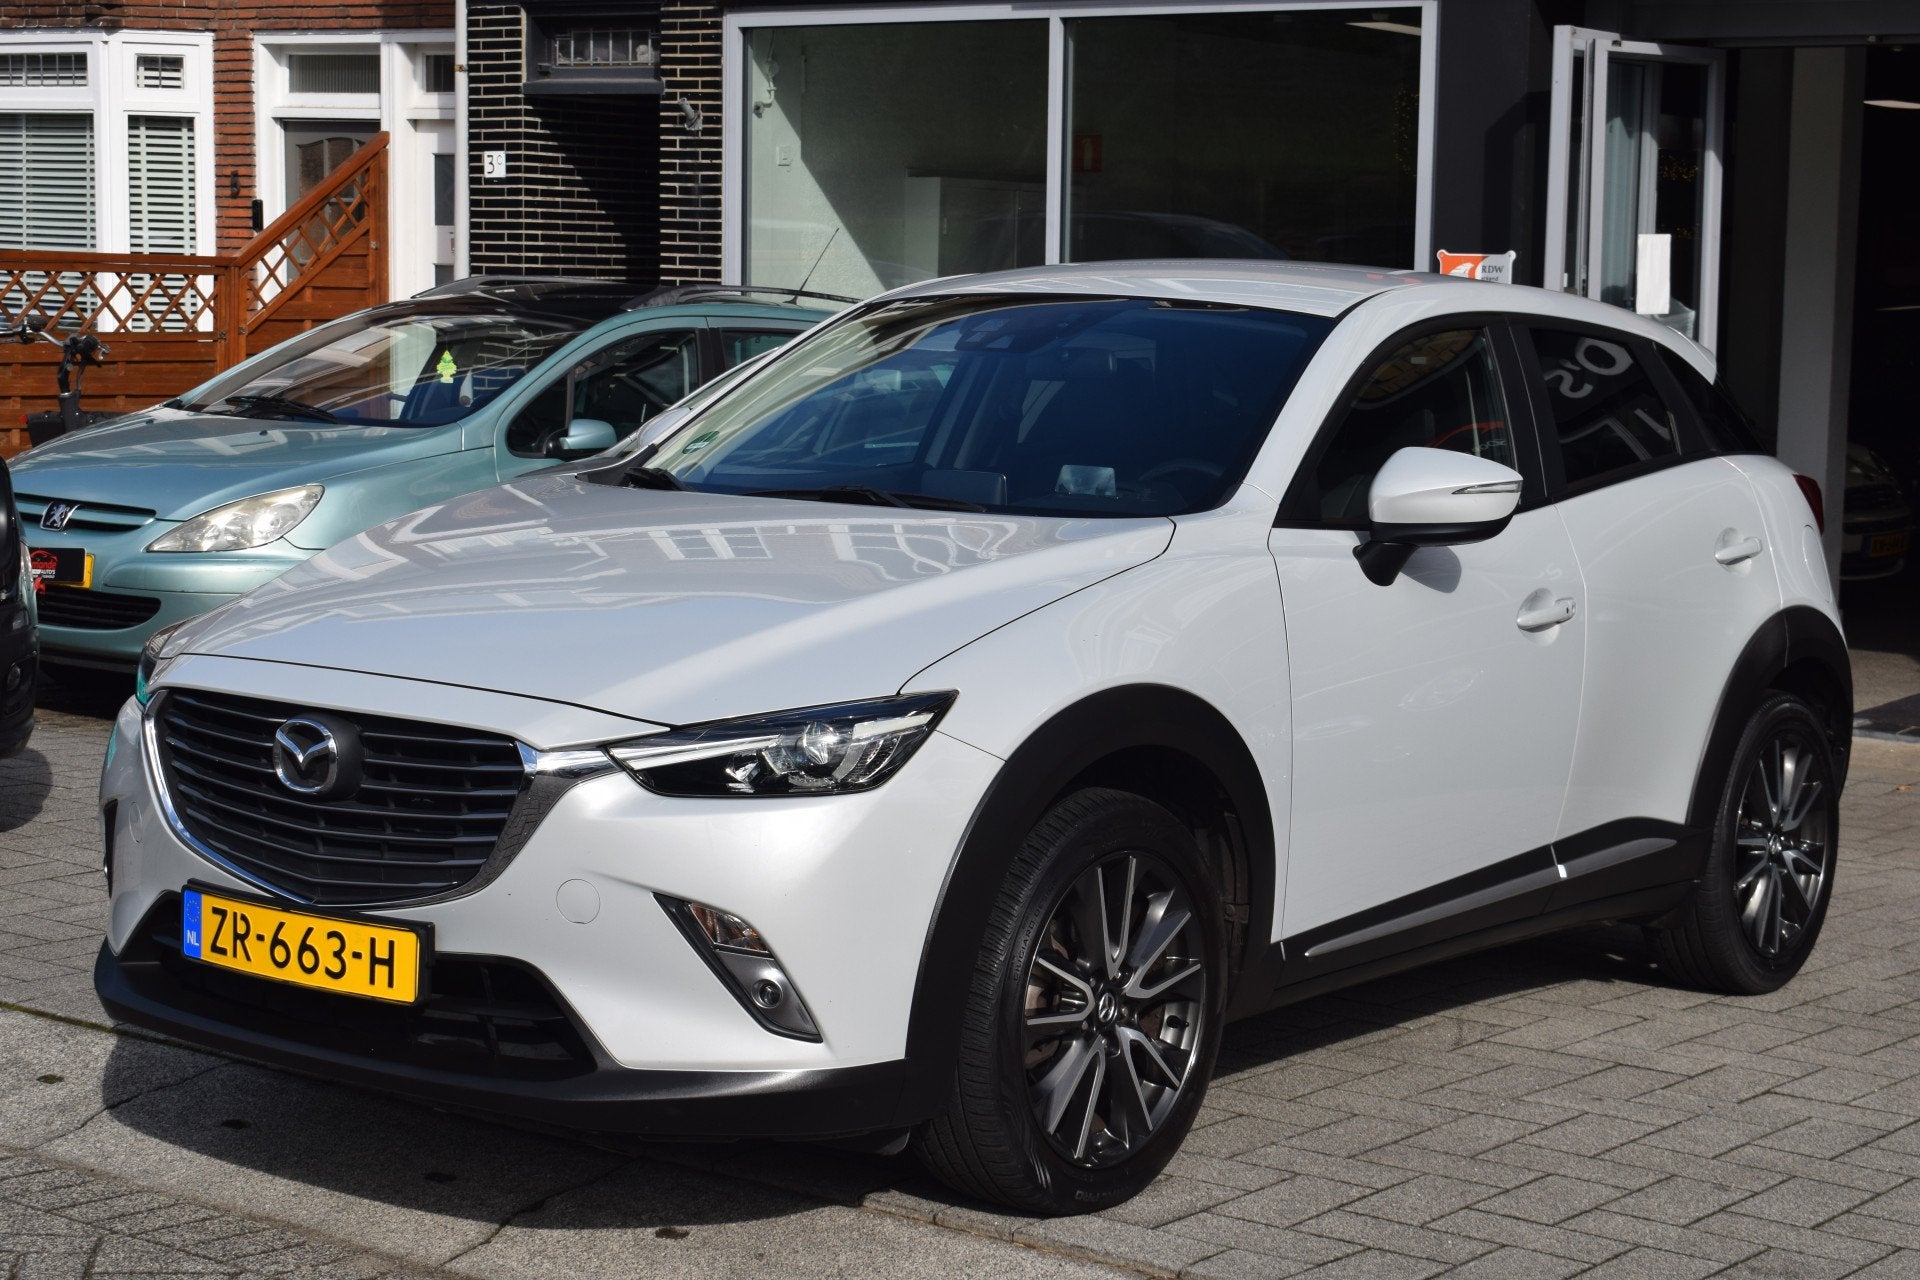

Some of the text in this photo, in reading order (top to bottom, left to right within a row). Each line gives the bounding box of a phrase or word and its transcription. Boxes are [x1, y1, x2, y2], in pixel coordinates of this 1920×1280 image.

[1482, 265, 1504, 273] RDW
[186, 930, 200, 947] NL
[210, 906, 396, 989] ZR-663-H
